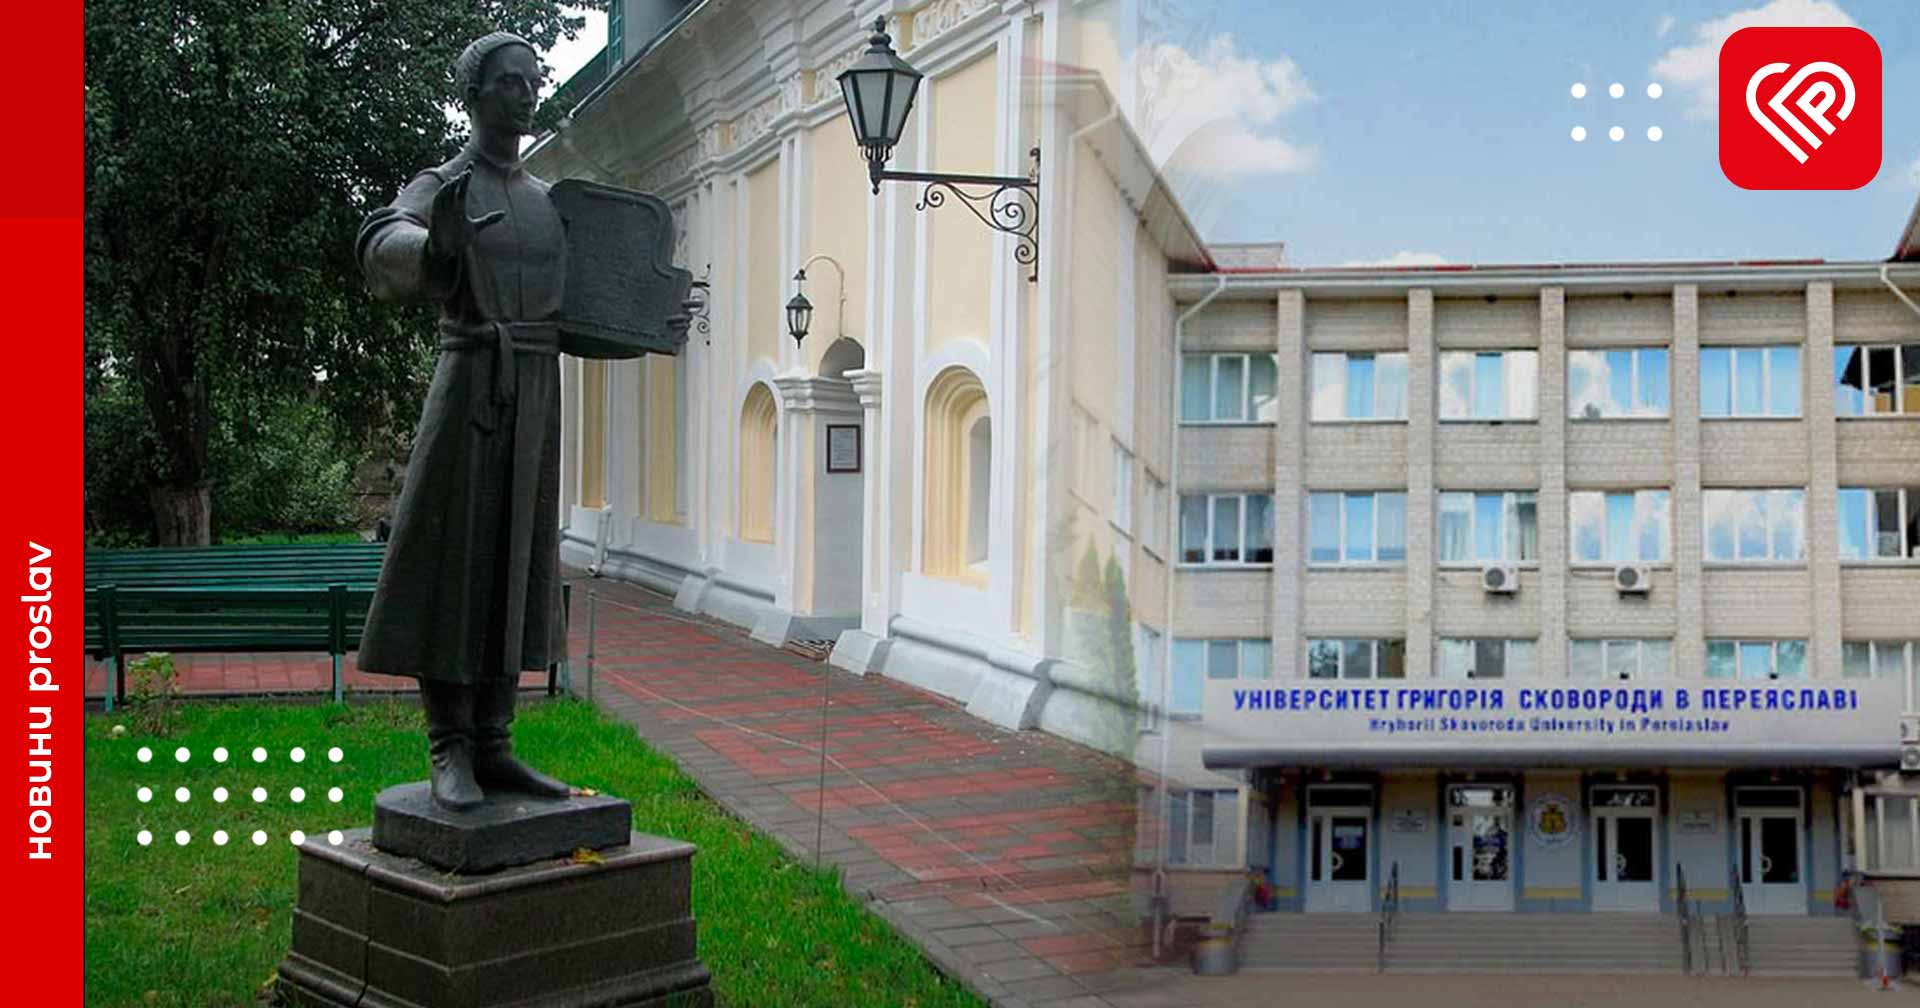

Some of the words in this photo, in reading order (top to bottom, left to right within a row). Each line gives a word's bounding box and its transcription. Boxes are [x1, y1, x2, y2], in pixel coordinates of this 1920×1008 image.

[1233, 688, 1390, 710] УНІВЕРСИТЕТ
[1396, 688, 1505, 710] ГРИГОРІЯ
[1518, 687, 1664, 713] СКОВОРОДИ
[1674, 687, 1690, 710] В
[1701, 687, 1858, 710] ПЕРЕЯСЛАВІ
[1529, 717, 1615, 734] University
[1618, 716, 1635, 732] in
